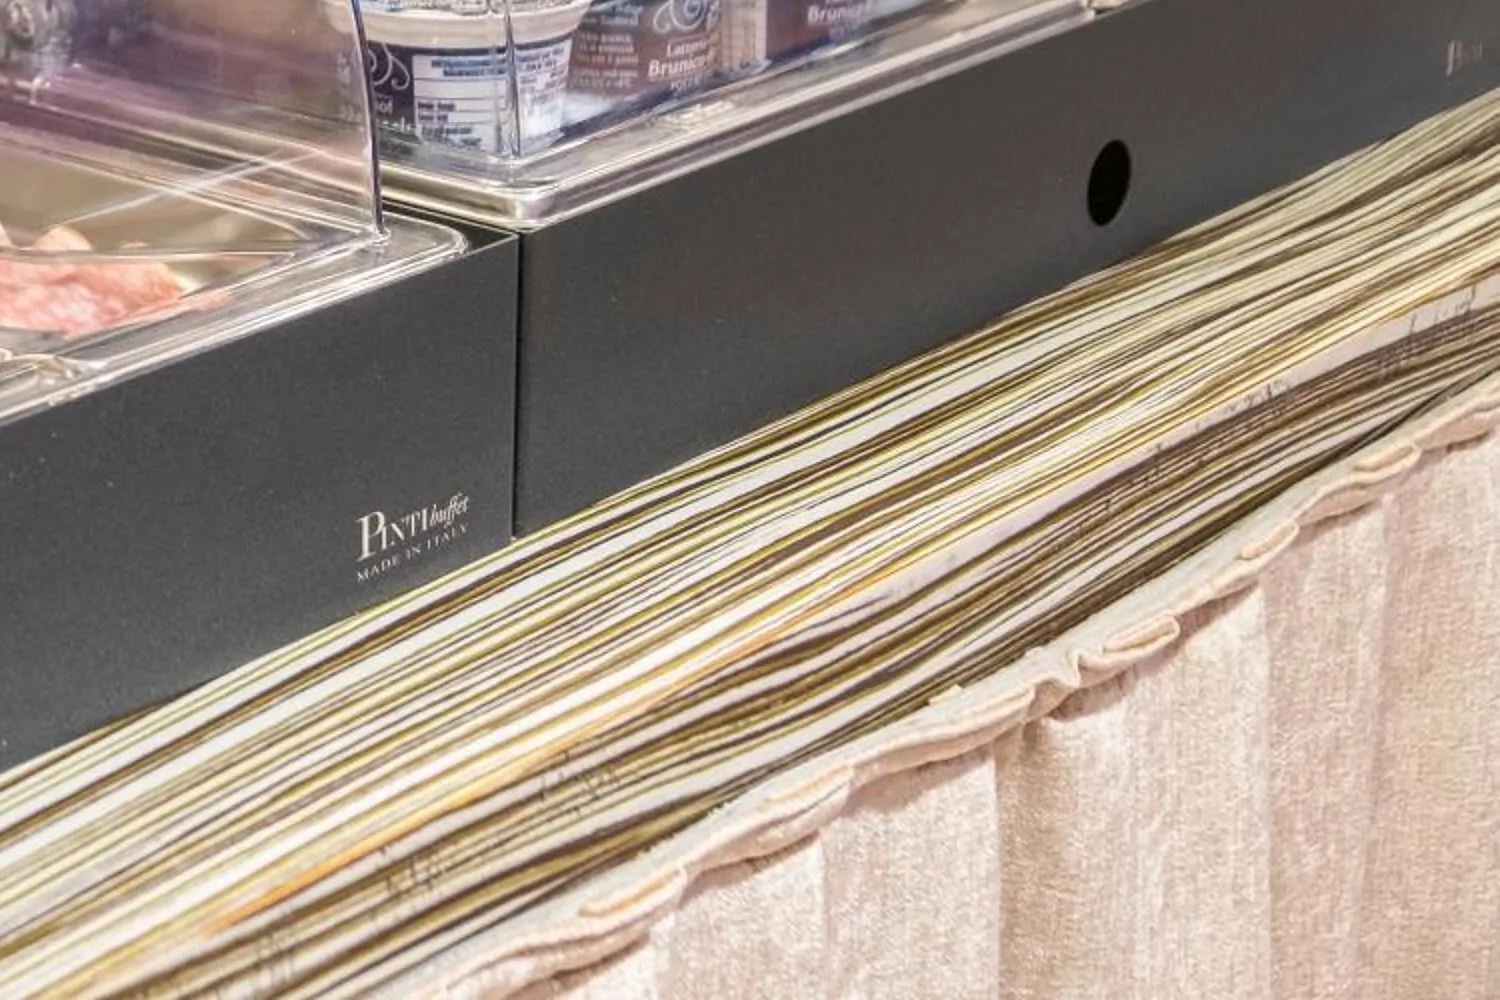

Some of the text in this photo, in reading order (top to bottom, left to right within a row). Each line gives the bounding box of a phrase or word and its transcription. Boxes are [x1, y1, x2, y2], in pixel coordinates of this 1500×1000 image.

[357, 522, 469, 584] MADE IN ITALY
